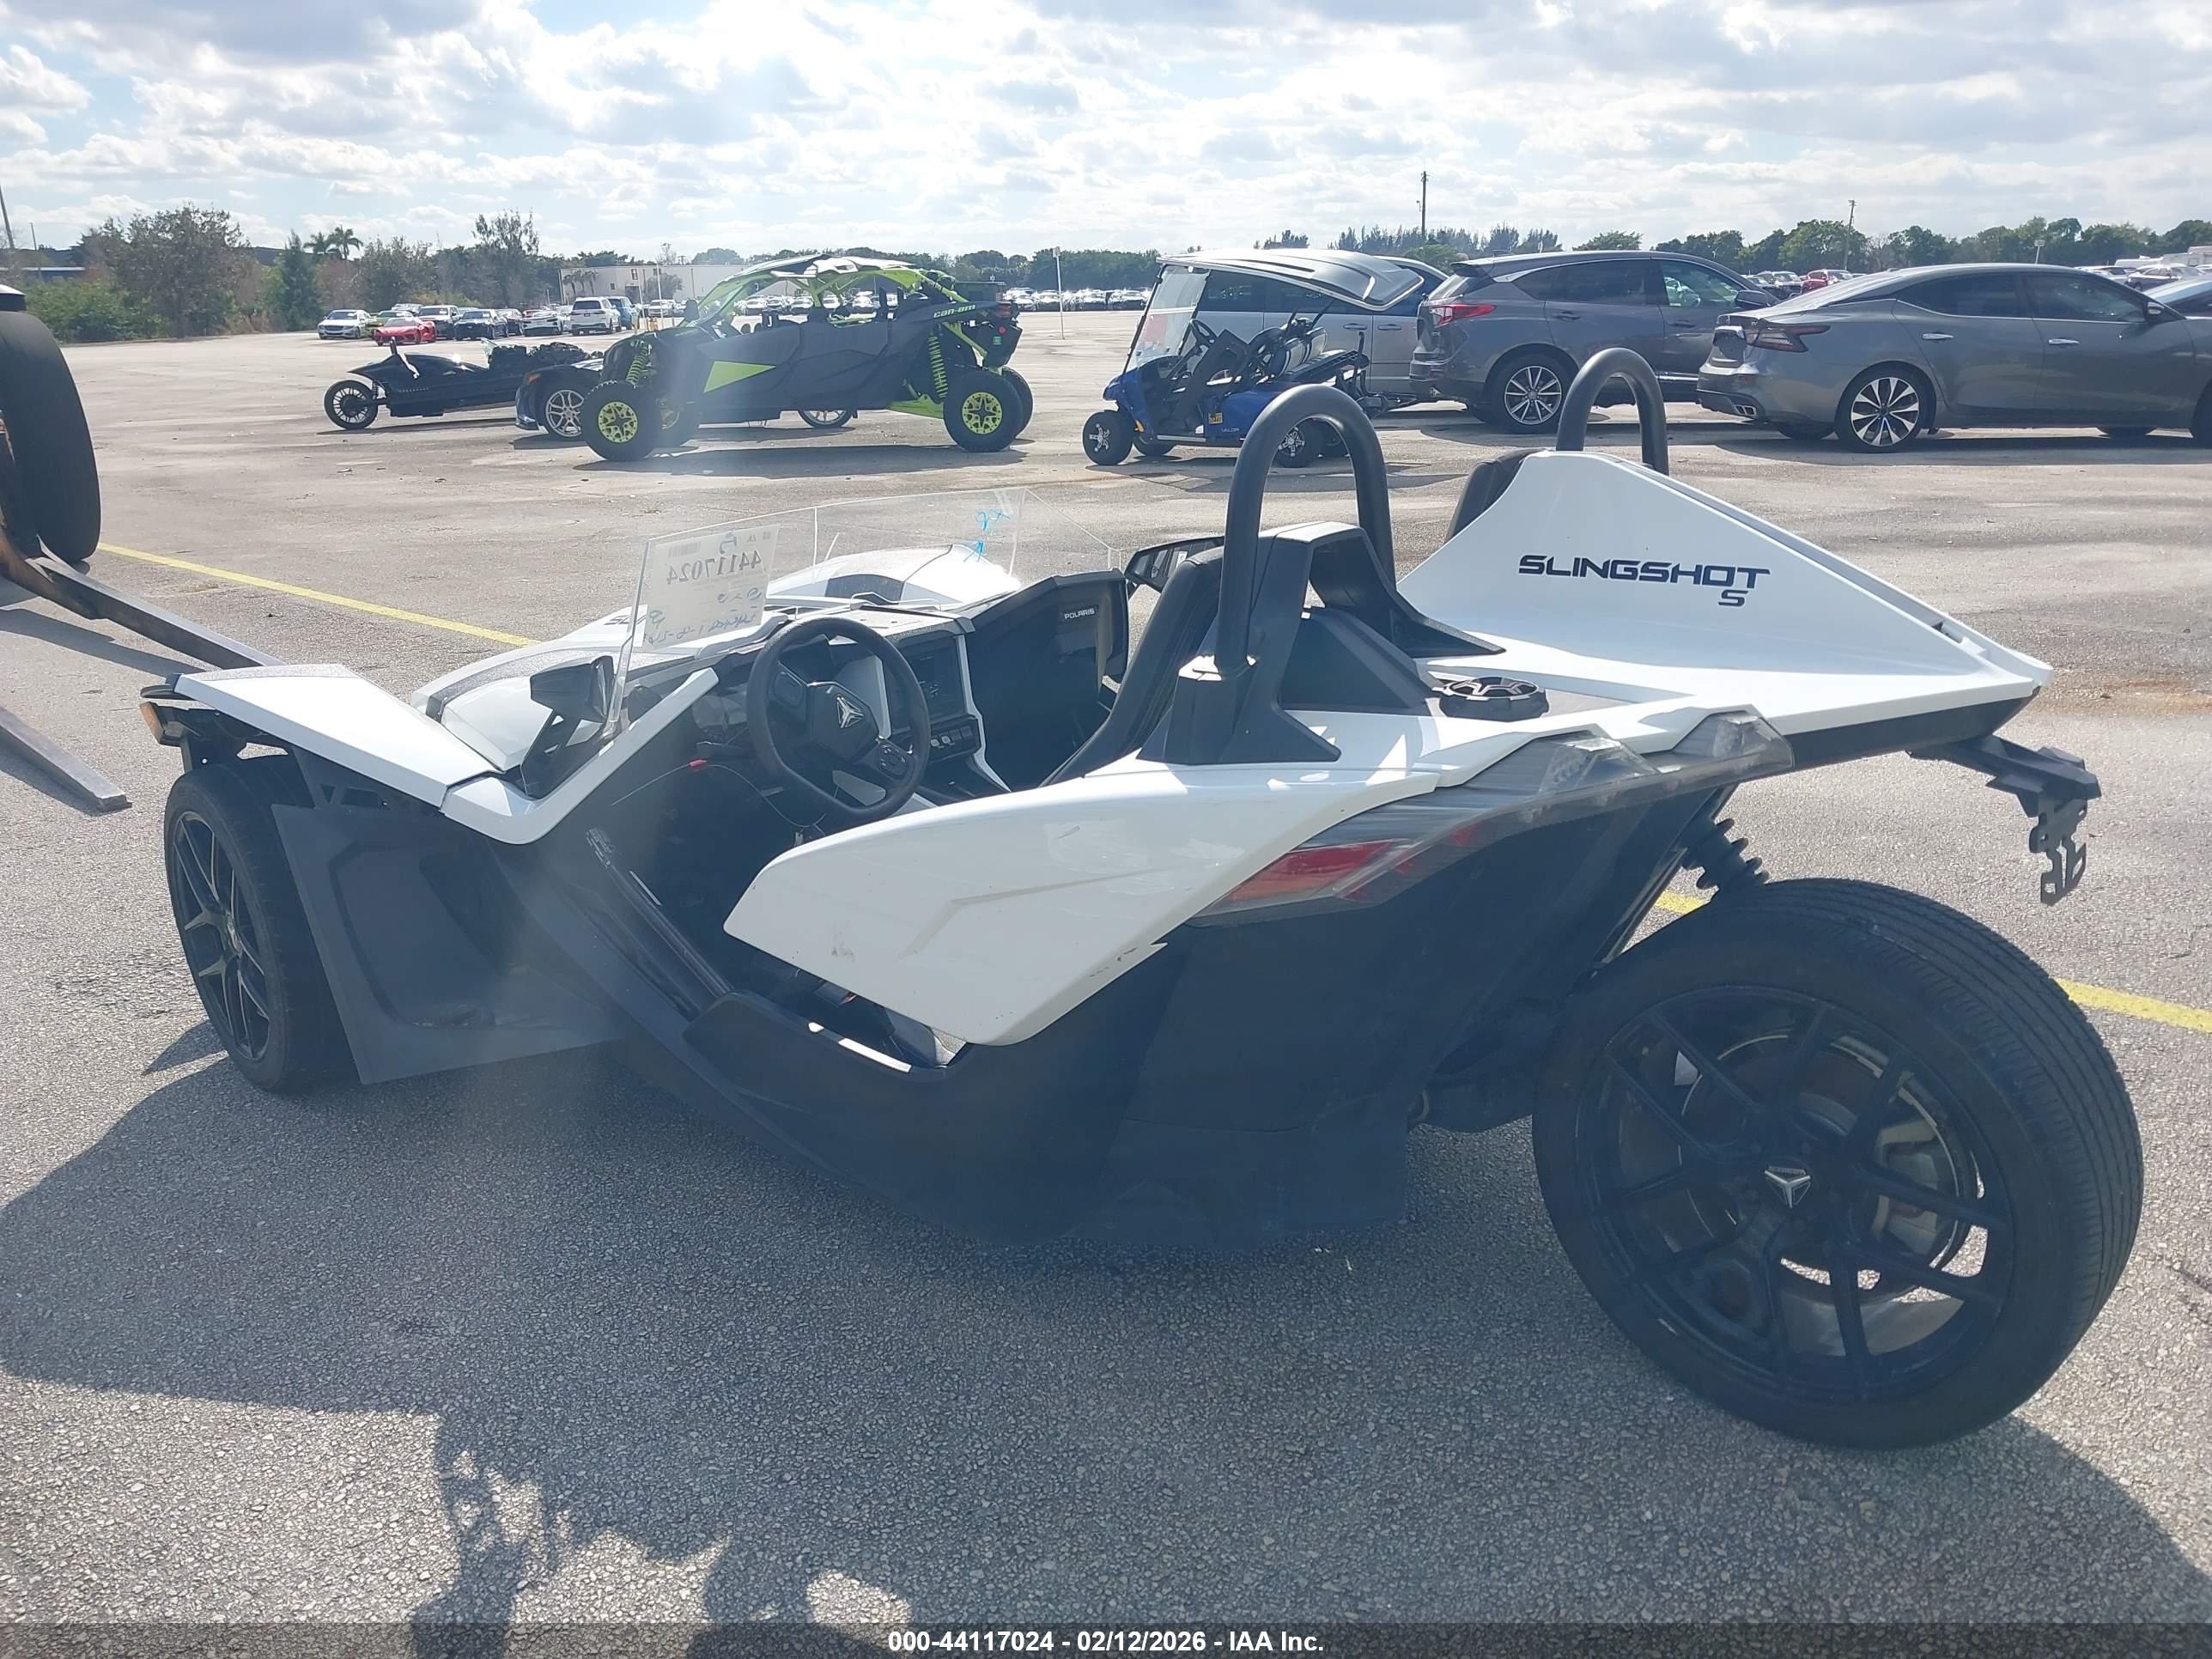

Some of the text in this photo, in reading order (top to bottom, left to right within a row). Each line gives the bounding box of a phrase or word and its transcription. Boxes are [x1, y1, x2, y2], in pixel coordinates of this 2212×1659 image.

[1518, 555, 1771, 588] SLINGSHOT
[1718, 589, 1748, 607] S
[1064, 608, 1096, 620] POLARIS
